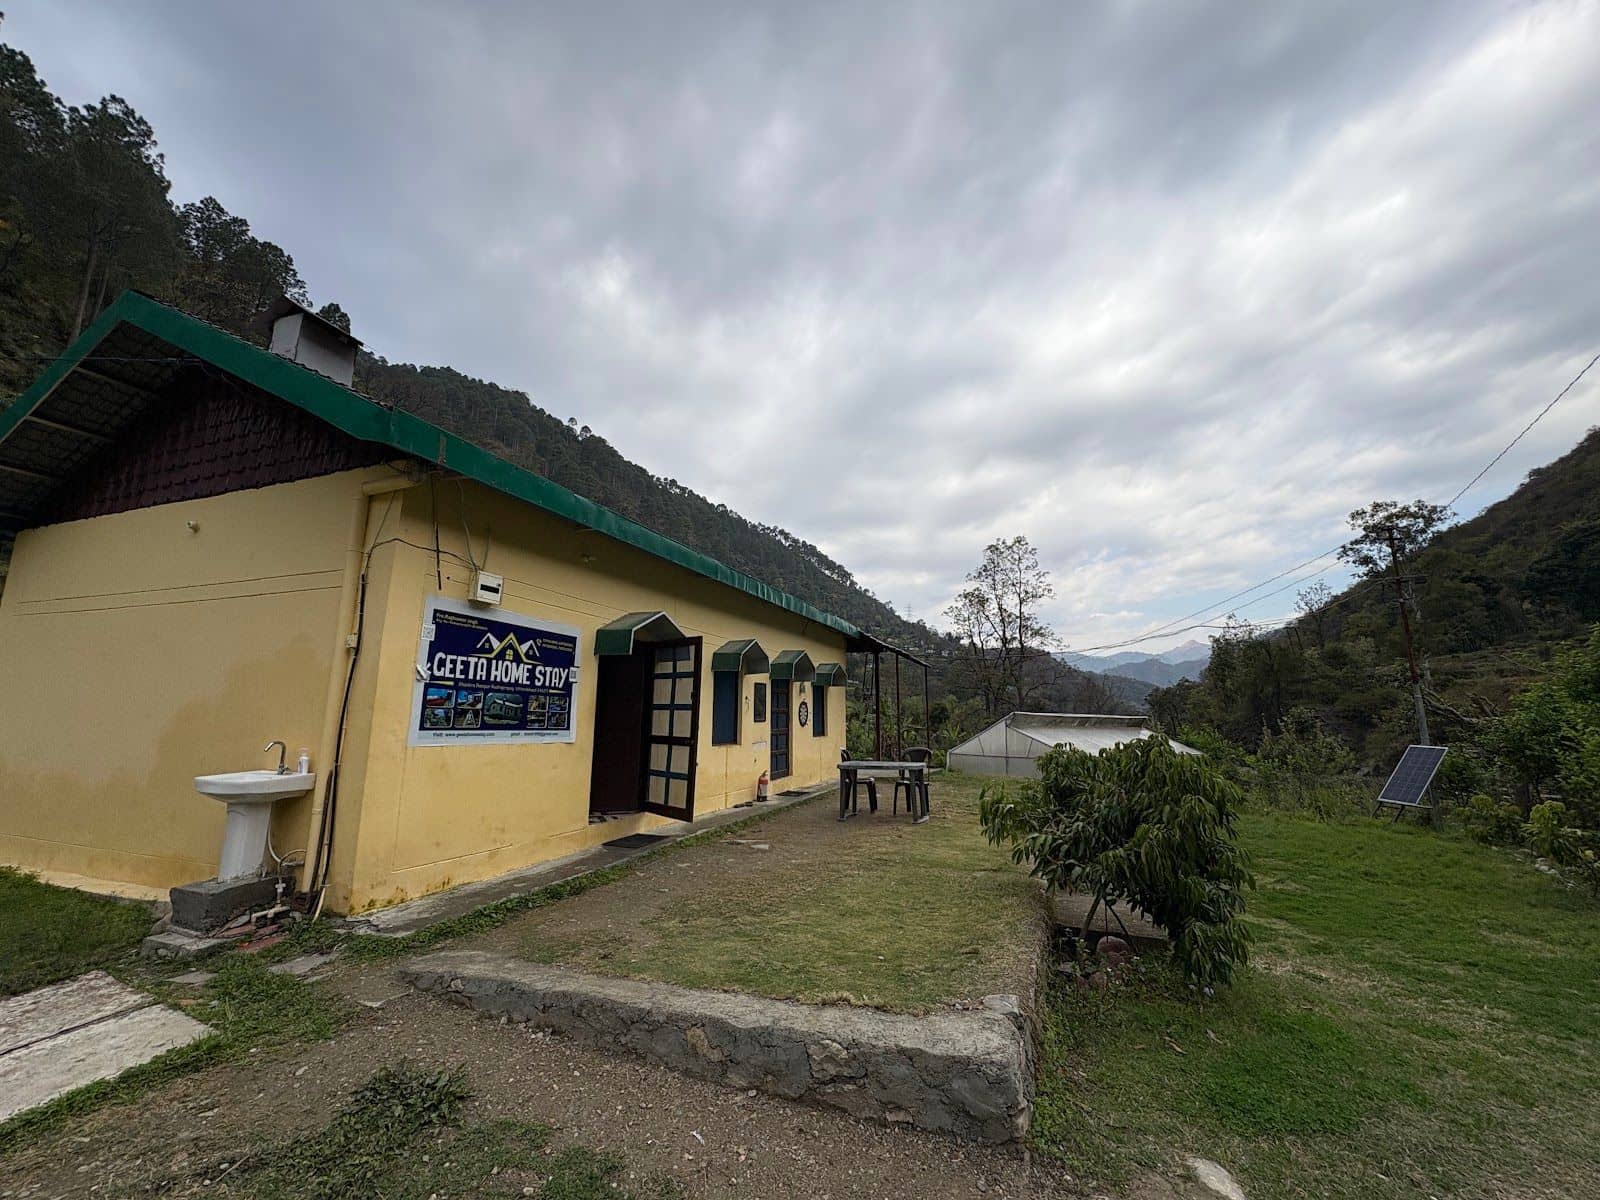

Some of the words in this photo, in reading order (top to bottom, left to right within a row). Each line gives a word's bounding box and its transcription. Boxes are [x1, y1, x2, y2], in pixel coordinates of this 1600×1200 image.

[433, 652, 487, 681] GEETA
[490, 660, 532, 685] HOME
[535, 665, 568, 688] STAY
